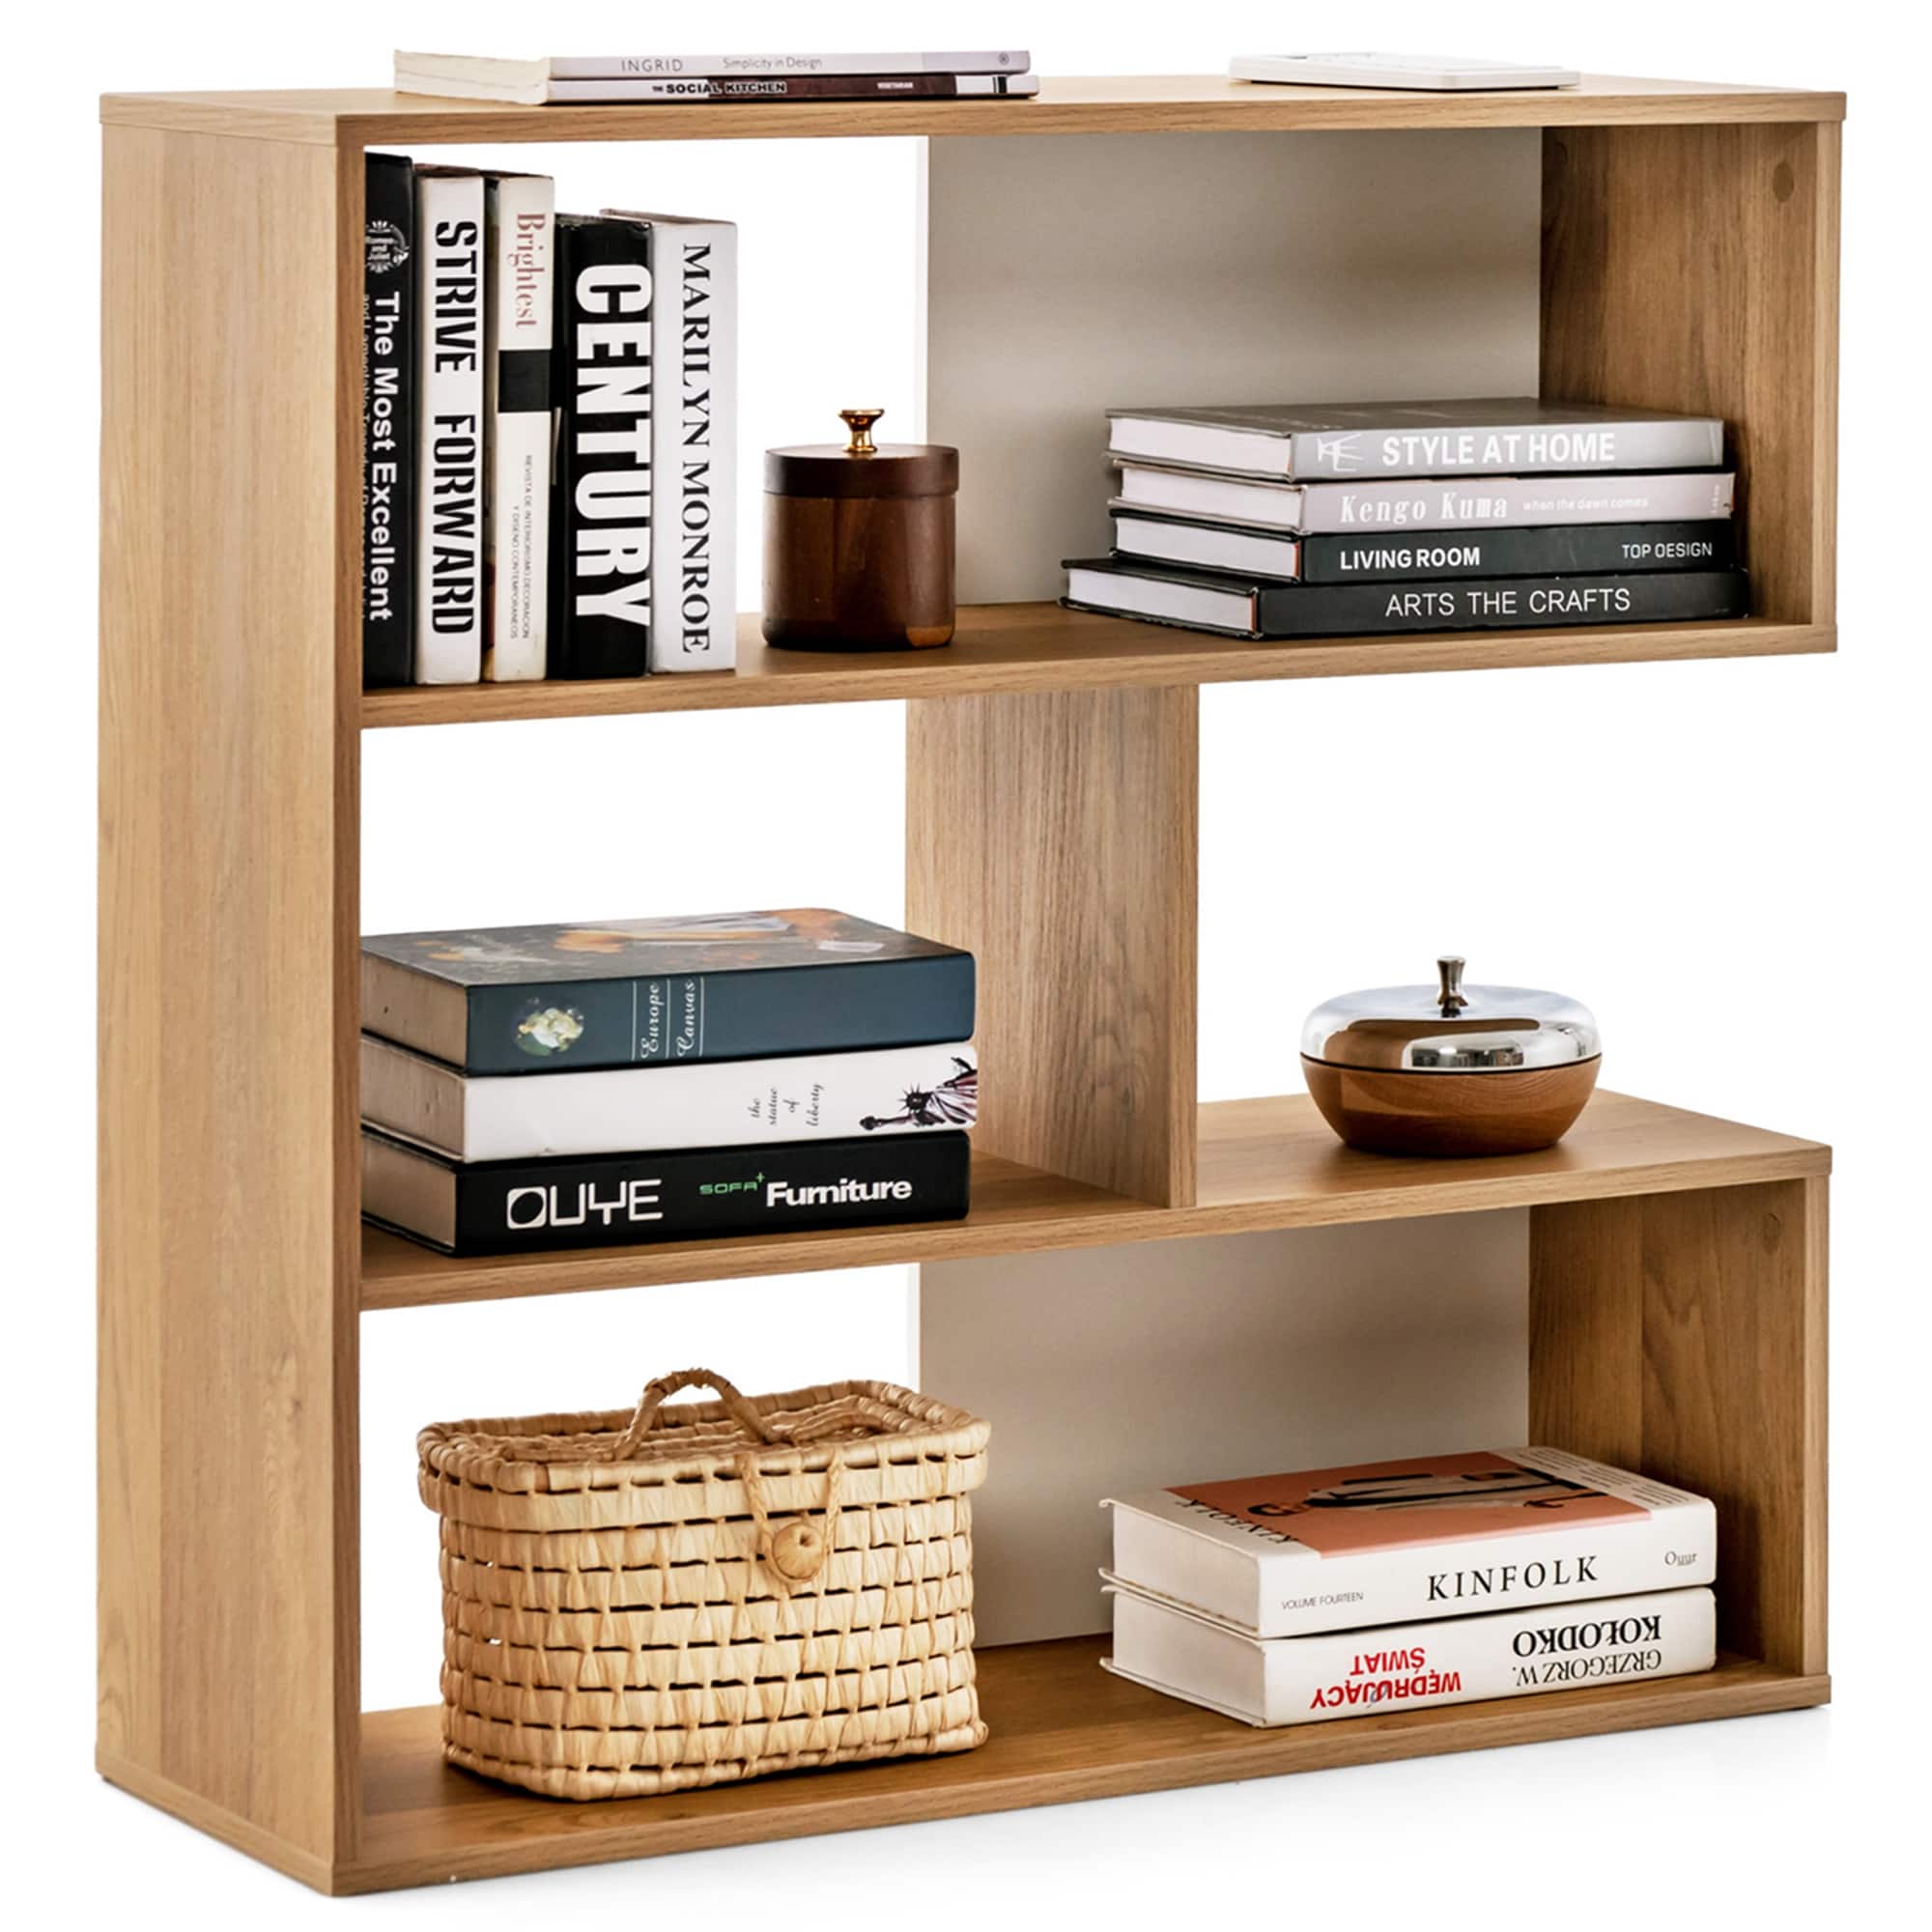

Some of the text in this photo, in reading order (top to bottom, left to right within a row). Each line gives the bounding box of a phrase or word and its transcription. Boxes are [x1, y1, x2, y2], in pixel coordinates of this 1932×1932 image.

[621, 57, 822, 71] INGRID Simplicity in Design
[667, 82, 723, 94] SOCIAL
[724, 81, 787, 94] KITCHEN
[507, 213, 546, 328] Brightest
[374, 291, 400, 355] The
[373, 367, 399, 451] Most
[432, 221, 477, 634] STRIVE FORWARD
[575, 264, 652, 626] CENTURY
[683, 242, 711, 652] MARILYN MONROE
[1382, 432, 1616, 467] STYLE AT HOME
[1340, 492, 1508, 526] Kengo Kuma
[1522, 497, 1649, 511] when the dawn comes
[369, 462, 397, 621] Excellent
[1340, 547, 1481, 571] LIVING ROOM
[1621, 544, 1652, 559] TOP
[1385, 588, 1631, 617] ARTS THE CRAFTS
[640, 981, 665, 1059] Europe
[675, 980, 696, 1057] Canvas
[747, 1097, 760, 1118] the
[767, 1088, 778, 1125] statue
[782, 1098, 801, 1114] of
[805, 1084, 825, 1126] liberty
[506, 1179, 663, 1229] OUYE
[766, 1178, 913, 1208] Furniture
[1426, 1554, 1599, 1602] KINFOLK
[1282, 1592, 1364, 1609] VOLUME FOURTEEN
[1513, 1614, 1662, 1659] KOŁODKO
[1350, 1647, 1426, 1677] ŚWIAT
[1512, 1649, 1662, 1687] GRZEGORZ W.
[1309, 1670, 1462, 1709] WĘDRUJĄCY
